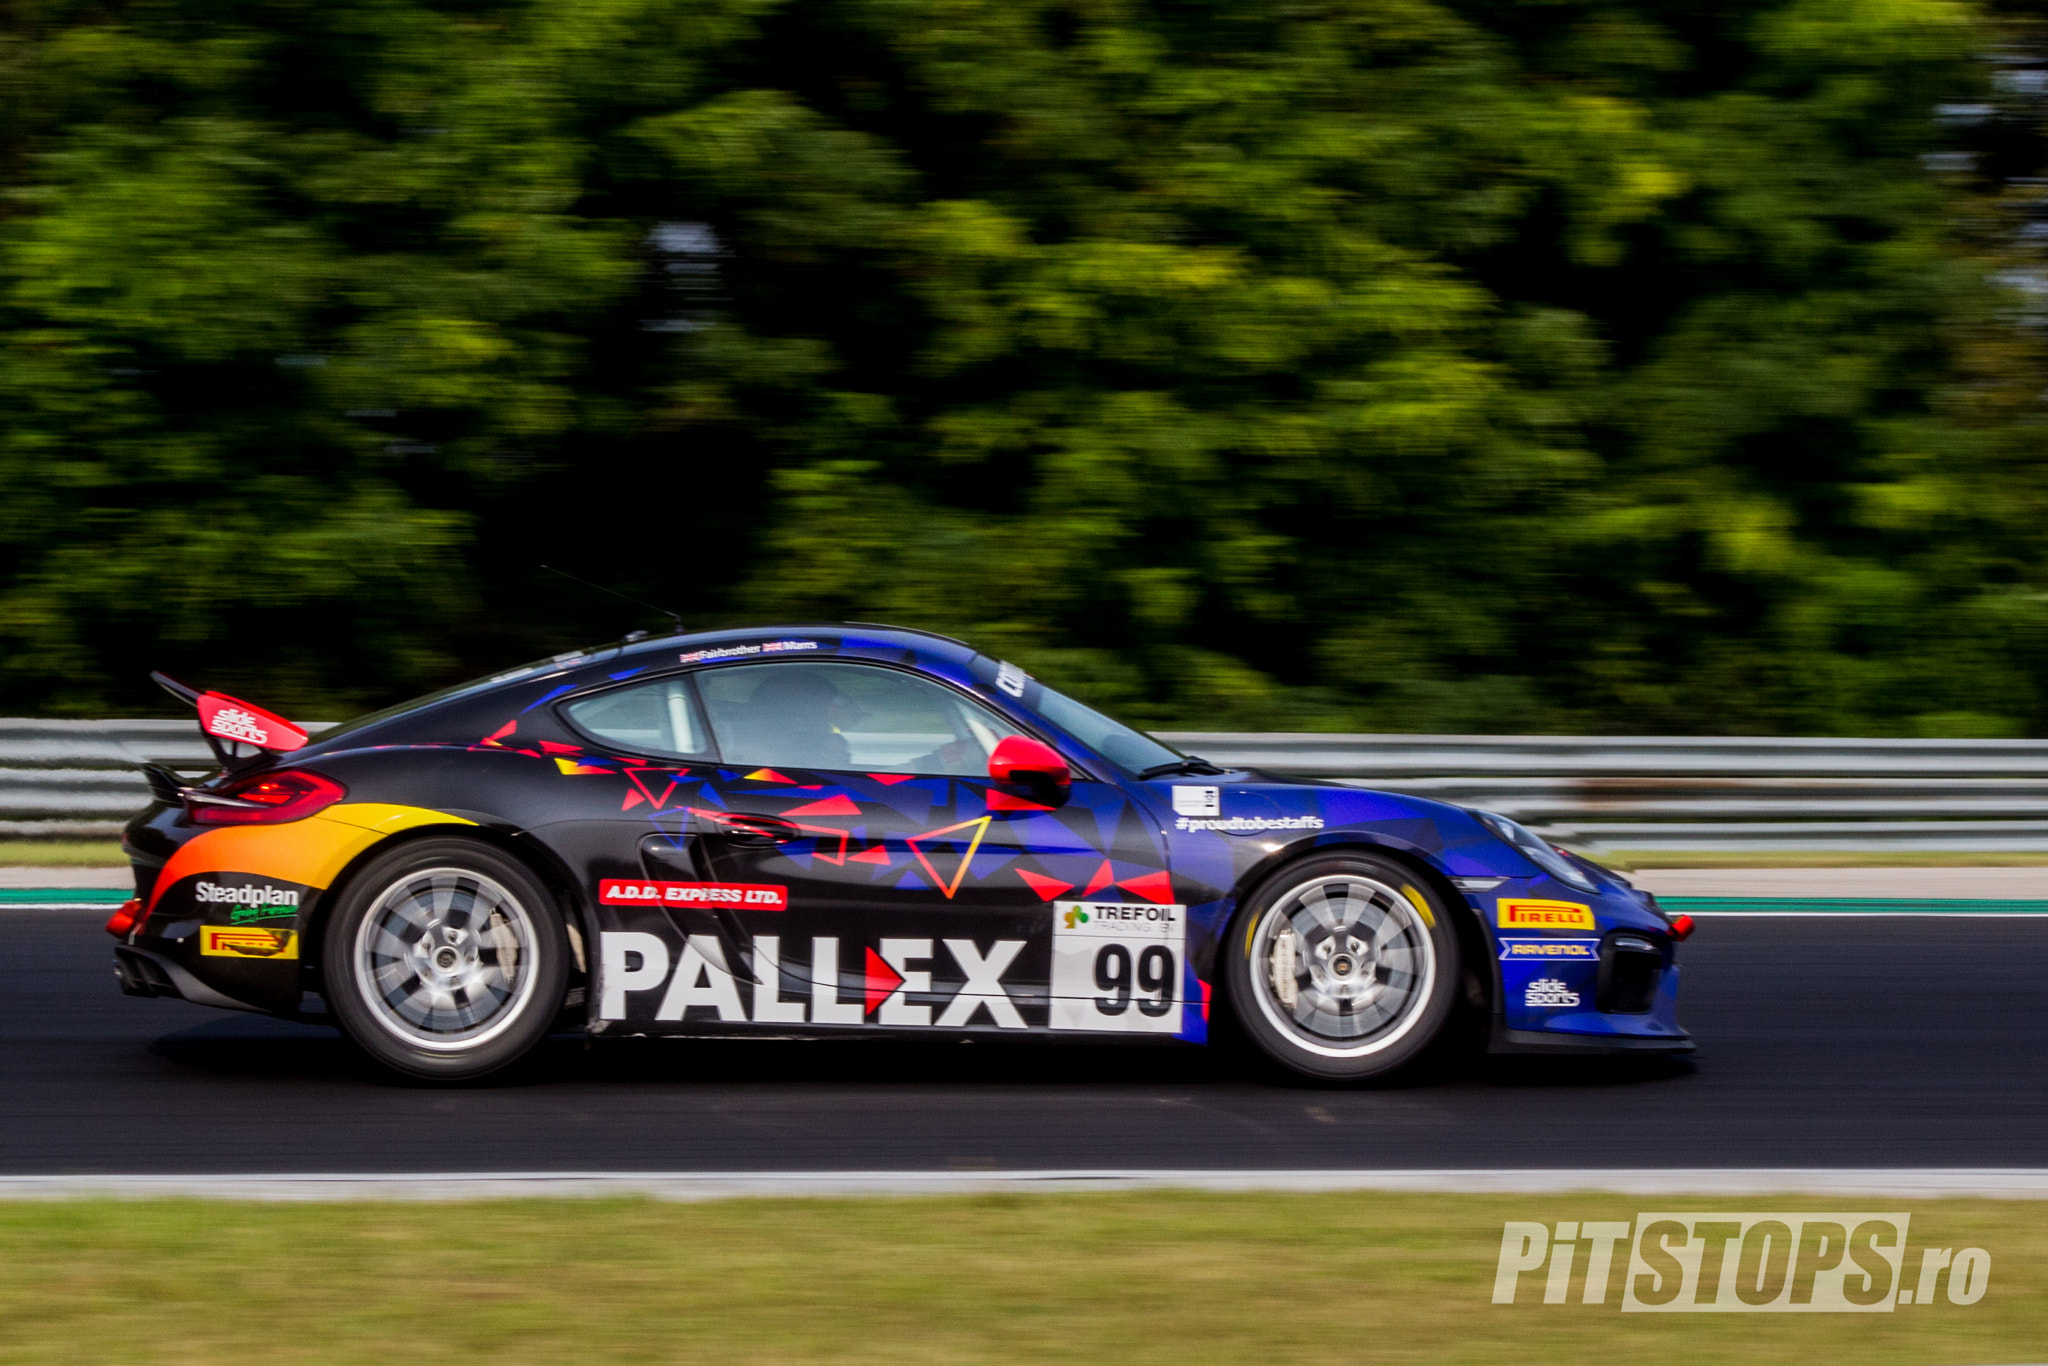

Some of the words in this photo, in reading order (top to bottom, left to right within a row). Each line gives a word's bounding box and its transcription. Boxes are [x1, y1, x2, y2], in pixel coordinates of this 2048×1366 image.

[213, 708, 257, 730] slide
[210, 719, 268, 744] sports
[1175, 815, 1325, 833] #proudtobestaffs
[195, 881, 299, 908] Steadplan
[606, 885, 661, 900] A.D.D.
[664, 887, 742, 904] EXPRESS
[744, 890, 782, 905] LTD.
[1094, 905, 1177, 922] TREFOIL
[1508, 904, 1585, 924] PIRELLI
[1511, 944, 1591, 956] RAVENOL
[1092, 943, 1176, 1018] 99
[1524, 978, 1570, 994] slide
[1524, 992, 1581, 1007] sports
